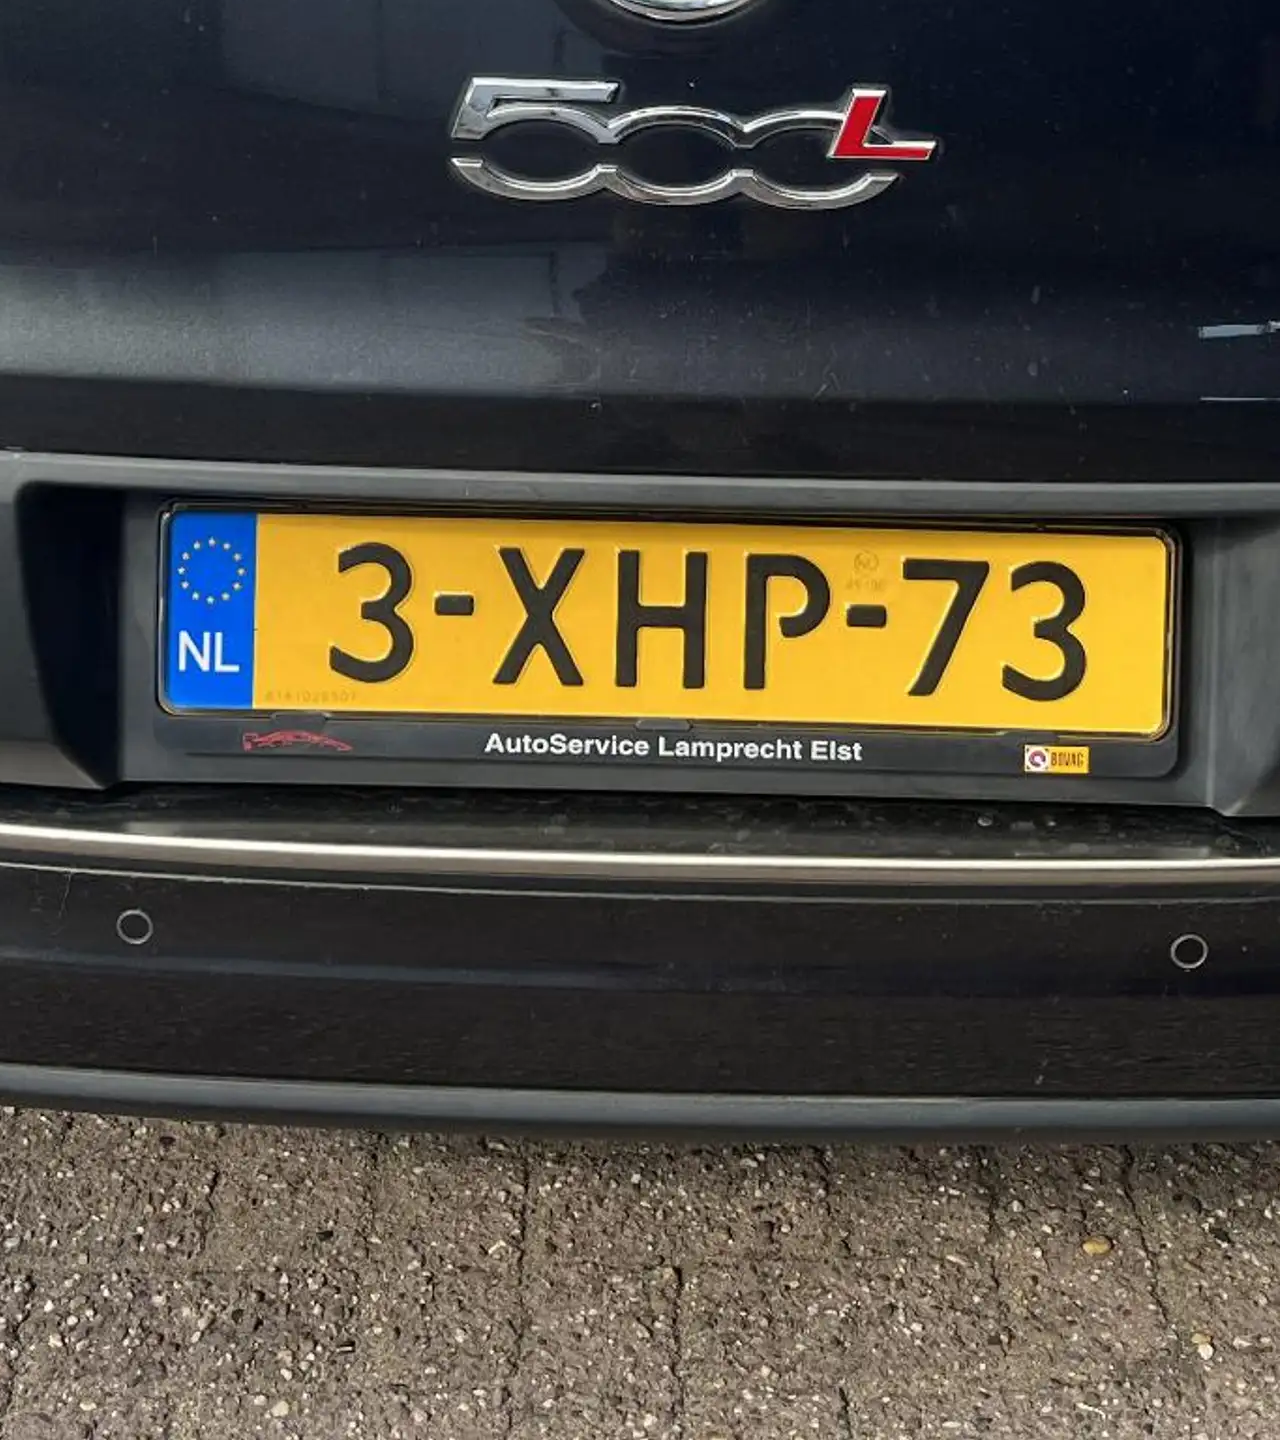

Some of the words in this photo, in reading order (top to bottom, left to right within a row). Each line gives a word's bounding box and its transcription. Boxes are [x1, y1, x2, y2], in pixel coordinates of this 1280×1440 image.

[450, 76, 937, 210] 500L
[178, 630, 240, 673] NL
[329, 542, 1087, 702] 3-XHP-73
[484, 732, 650, 757] AutoService
[657, 736, 803, 763] Lamprecht
[810, 740, 863, 761] Elst
